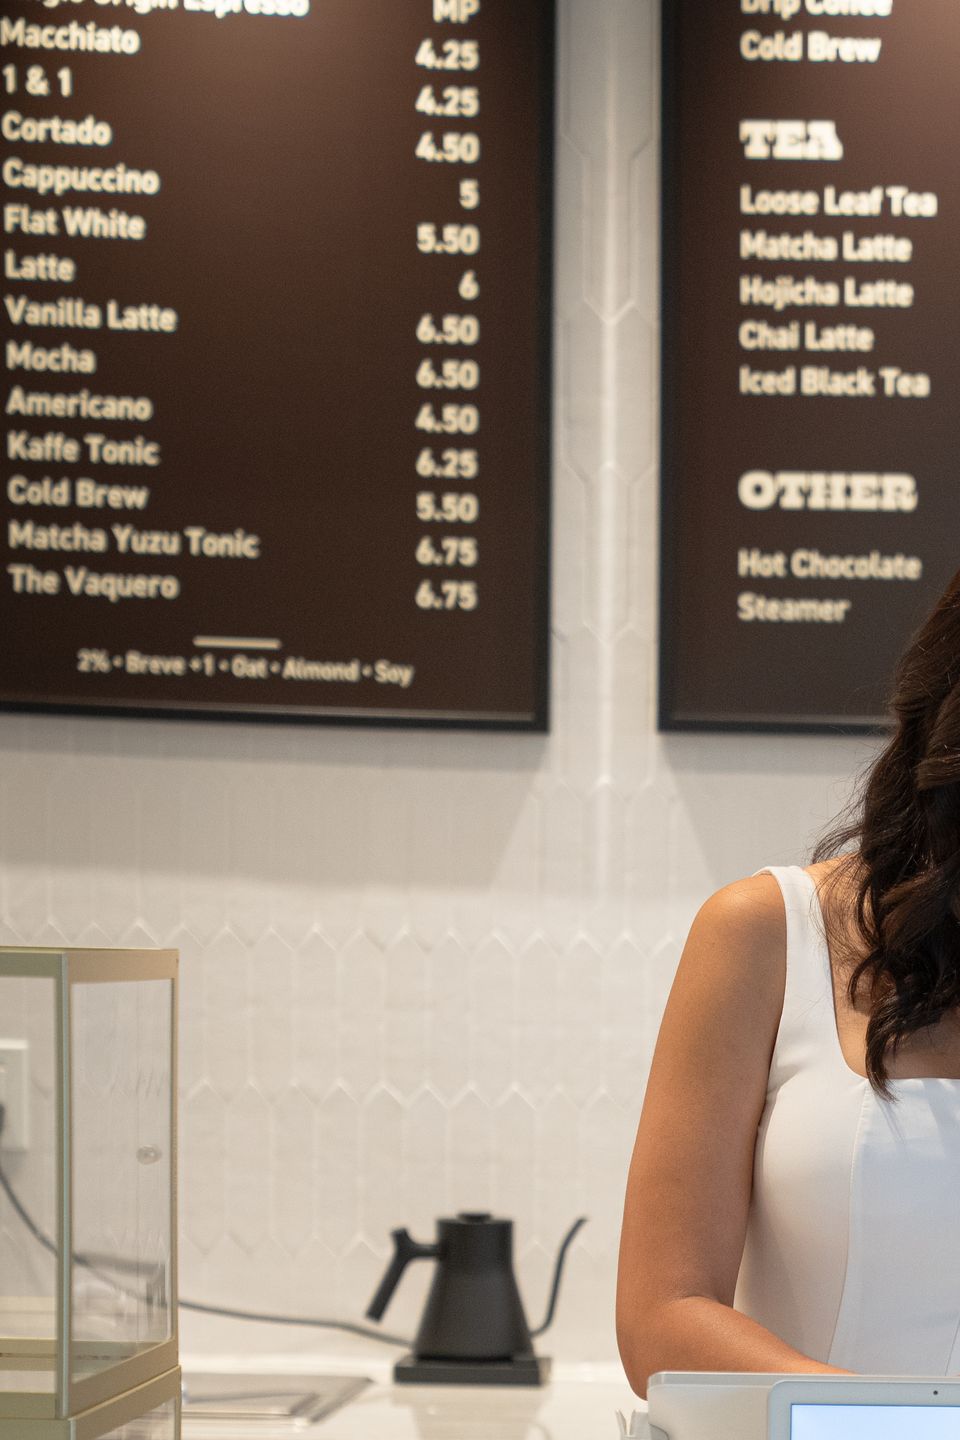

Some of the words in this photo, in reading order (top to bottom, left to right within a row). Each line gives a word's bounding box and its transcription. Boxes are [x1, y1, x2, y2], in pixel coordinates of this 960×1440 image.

[432, 0, 480, 24] MP
[0, 17, 140, 55] Macchiato
[740, 30, 803, 61] Cold
[807, 30, 882, 63] Brew
[415, 38, 480, 71] 4.25
[2, 64, 16, 94] 1
[25, 65, 50, 96] &
[57, 67, 72, 98] 1
[415, 85, 480, 118] 4.25
[2, 111, 113, 147] Cortado
[740, 119, 843, 161] TEA
[415, 131, 480, 164] 4.50
[2, 157, 161, 196] Cappuccino
[459, 179, 480, 210] 5
[740, 185, 819, 216] Loose
[823, 185, 883, 216] Leaf
[885, 186, 938, 218] Tea
[3, 203, 58, 236] Flat
[63, 206, 146, 240] White
[416, 223, 480, 255] 5.50
[740, 230, 838, 261] Matcha
[843, 231, 913, 263] Latte
[4, 249, 76, 282] Latte
[458, 270, 479, 300] 6
[740, 275, 840, 311] Hojicha
[844, 277, 914, 308] Latte
[4, 295, 102, 329] Vanilla
[106, 300, 178, 333] Latte
[415, 314, 480, 345] 6.50
[739, 320, 800, 351] Chai
[804, 322, 875, 352] Latte
[6, 341, 96, 374] Mocha
[415, 359, 479, 390] 6.50
[740, 366, 796, 396] Iced
[801, 366, 876, 397] Black
[879, 367, 931, 398] Tea
[6, 386, 153, 421] Americano
[415, 404, 479, 435] 4.50
[8, 430, 80, 464] Kaffe
[84, 433, 159, 466] Tonic
[415, 448, 478, 479] 6.25
[7, 475, 70, 507] Cold
[75, 478, 149, 509] Brew
[416, 492, 479, 523] 5.50
[738, 470, 918, 512] OTHER
[8, 520, 107, 552] Matcha
[112, 524, 181, 555] Yuzu
[185, 526, 259, 559] Tonic
[415, 536, 478, 567] 6.75
[738, 548, 786, 578] Hot
[790, 549, 923, 581] Chocolate
[8, 563, 60, 595] The
[64, 565, 180, 603] Vaquero
[415, 580, 478, 610] 6.75
[737, 592, 851, 623] Steamer
[77, 649, 111, 673] 2%
[125, 650, 186, 677] Breve
[231, 655, 268, 679] Oat
[282, 656, 361, 683] Almond
[374, 660, 414, 688] Soy
